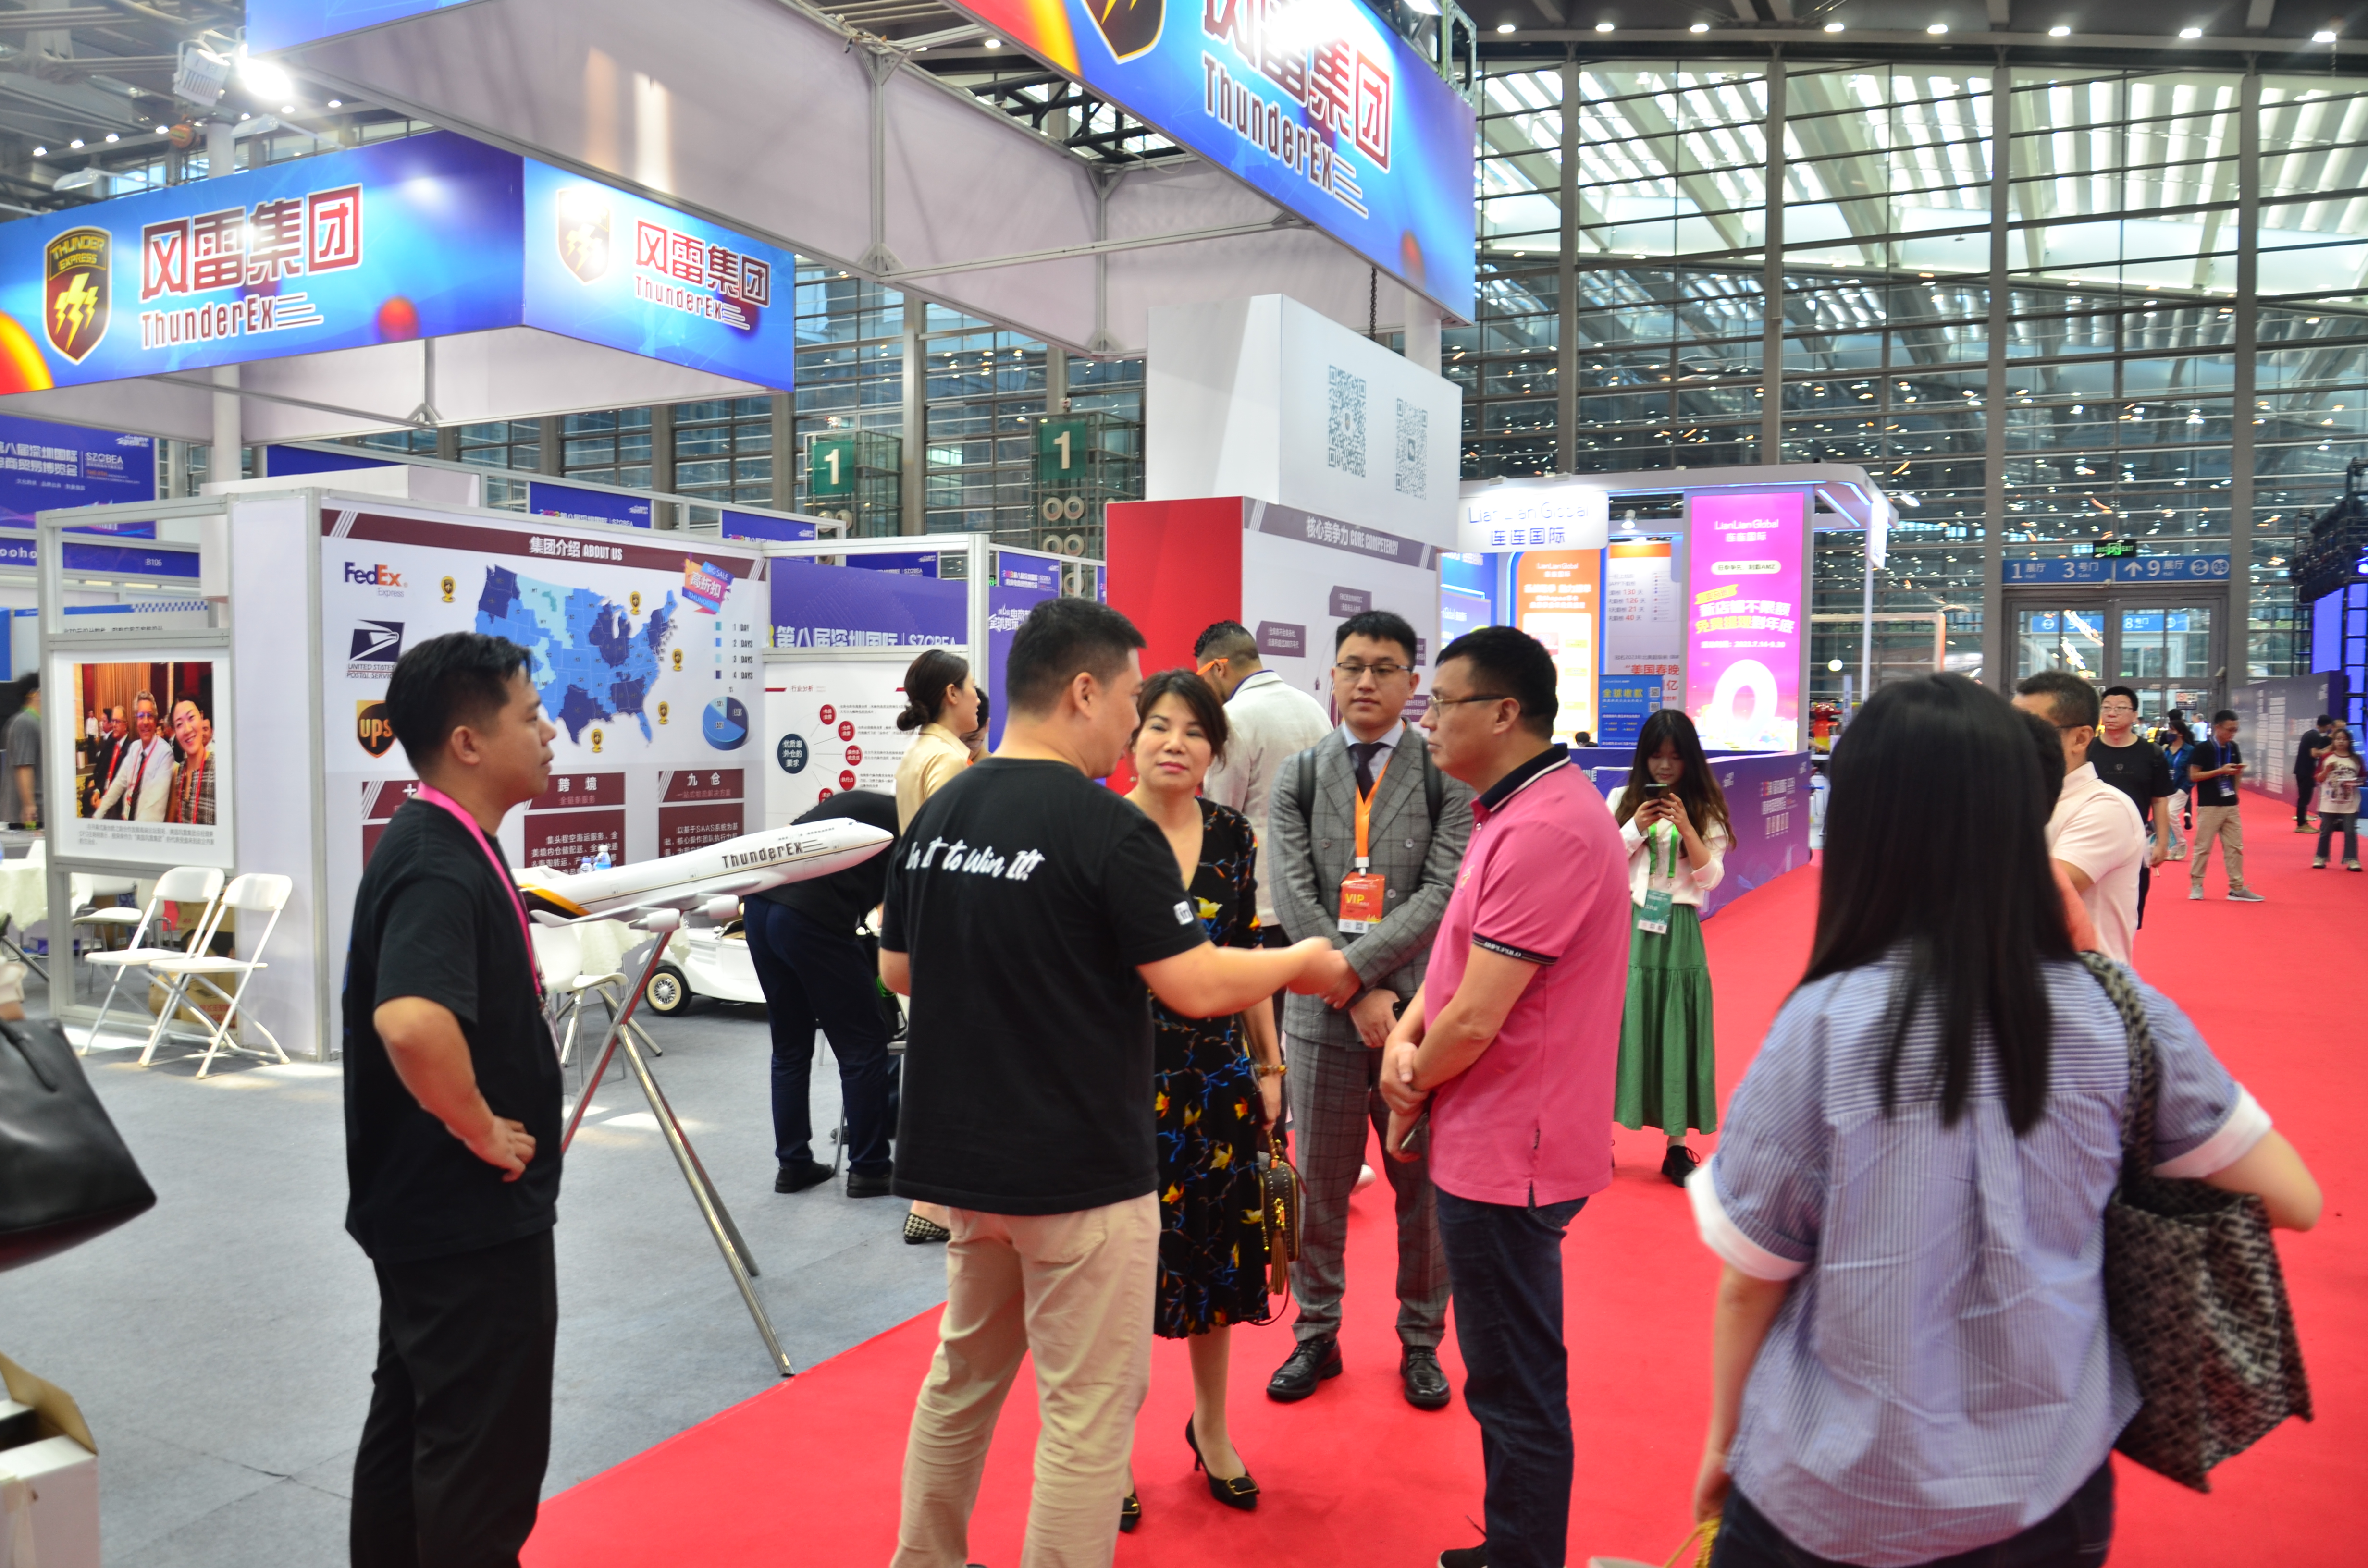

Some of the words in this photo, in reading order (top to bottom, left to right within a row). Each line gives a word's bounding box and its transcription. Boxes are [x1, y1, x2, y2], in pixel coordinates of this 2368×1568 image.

[1202, 50, 1334, 196] ThunderEx
[50, 236, 104, 255] THUNDER
[140, 184, 362, 302] 风雷集团
[58, 252, 98, 267] EXPRESS
[635, 217, 771, 308] 风雷集团
[634, 274, 722, 322] ThunderEx
[140, 294, 277, 349] ThunderEx
[1053, 431, 1070, 469] 1
[824, 448, 839, 484] 1
[1306, 516, 1348, 546] 核心竞争力
[1350, 529, 1365, 549] CORE
[1366, 533, 1398, 556] COMPETENCY
[1492, 527, 1565, 546] 连连国际
[1714, 520, 1751, 530] LianLian
[1752, 519, 1778, 528] Global
[529, 536, 580, 558] 集团介绍
[582, 544, 609, 560] ABOUT
[612, 547, 623, 561] US
[345, 561, 402, 587] FedEx
[2011, 563, 2022, 579] 1
[2025, 563, 2046, 573] 展厅
[2063, 562, 2075, 578] 3
[2079, 562, 2098, 572] 号门
[2147, 560, 2160, 576] 9
[2164, 560, 2185, 570] 展厅
[378, 588, 404, 597] Express
[691, 571, 721, 598] 高折扣
[2125, 618, 2134, 628] 8
[741, 656, 753, 664] DAYS
[741, 672, 753, 680] DAYS
[721, 841, 803, 869] ThunderEx
[942, 839, 968, 871] to
[1345, 894, 1364, 904] VIP
